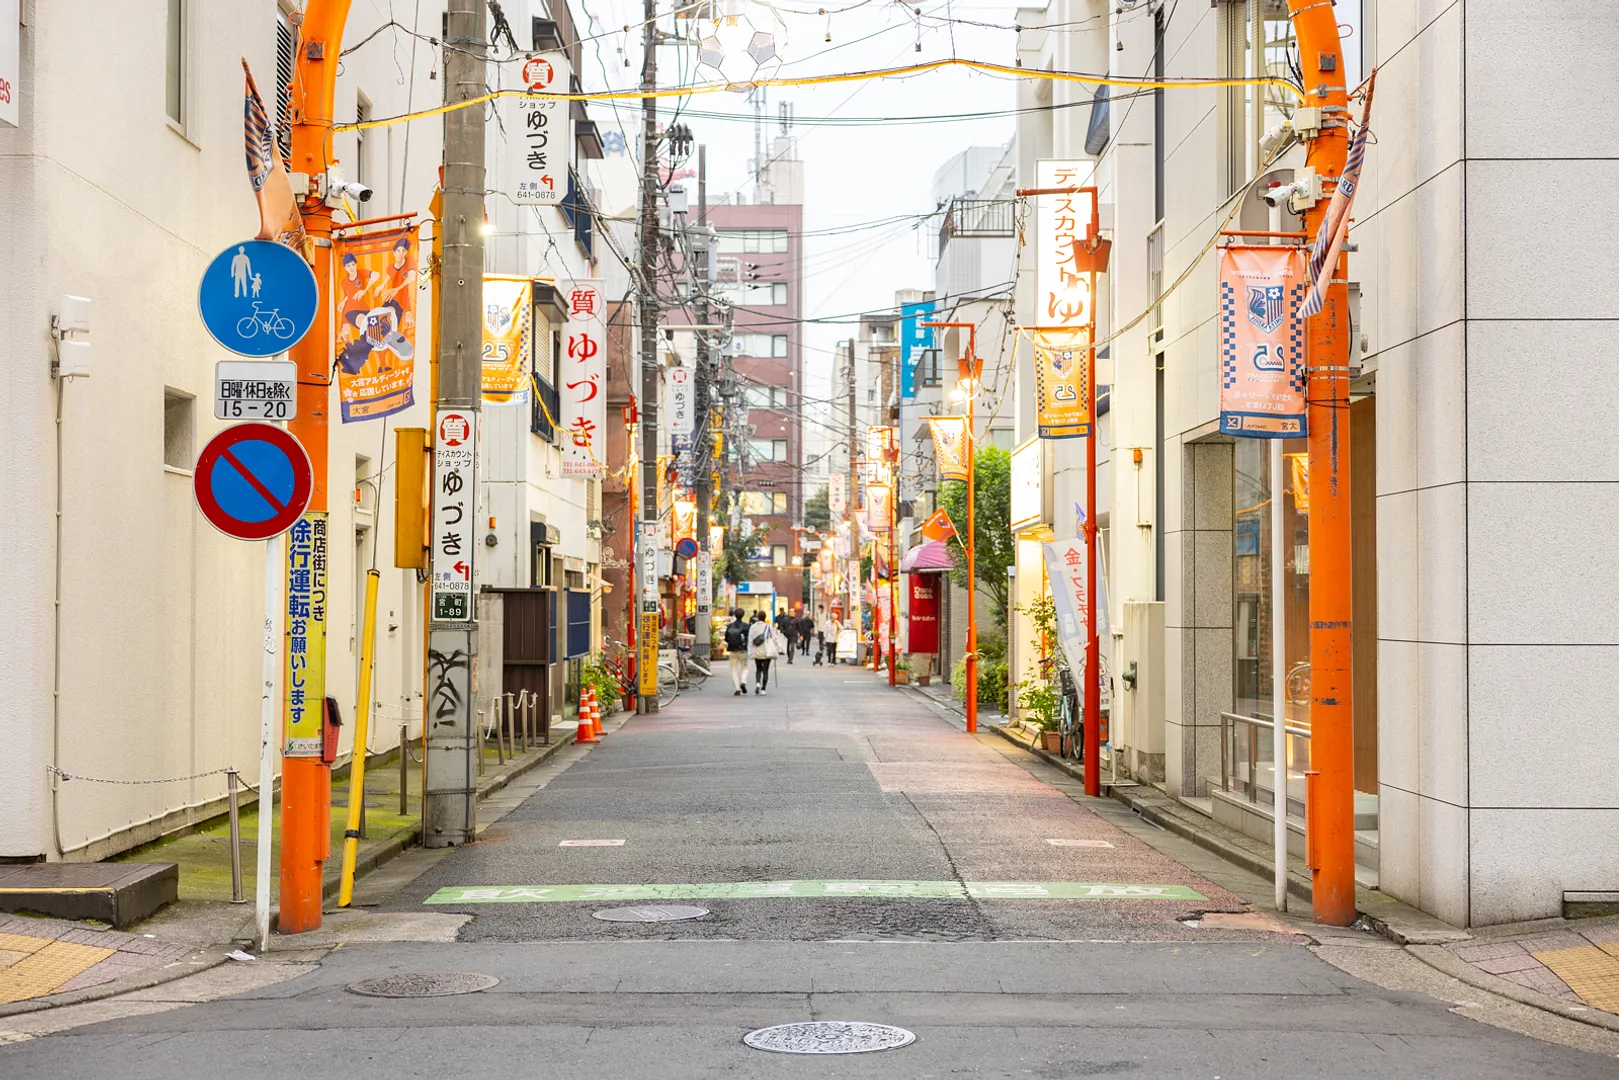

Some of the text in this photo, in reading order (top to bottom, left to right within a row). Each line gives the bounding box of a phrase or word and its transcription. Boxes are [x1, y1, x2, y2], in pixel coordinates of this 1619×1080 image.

[526, 110, 549, 170] ゆづき
[517, 190, 556, 200] 641-0878
[519, 182, 538, 191] 左側
[570, 290, 596, 315] 質
[221, 381, 290, 399] 日曜・休日を除く
[566, 333, 600, 447] ゆづき
[353, 405, 370, 415] 大宮
[441, 471, 464, 556] ゆづき
[312, 518, 327, 622] 商店街につき
[434, 571, 452, 582] 左側
[434, 581, 470, 591] 641-0878
[288, 518, 312, 724] 徐行運転お願いします
[439, 608, 462, 616] 1-89
